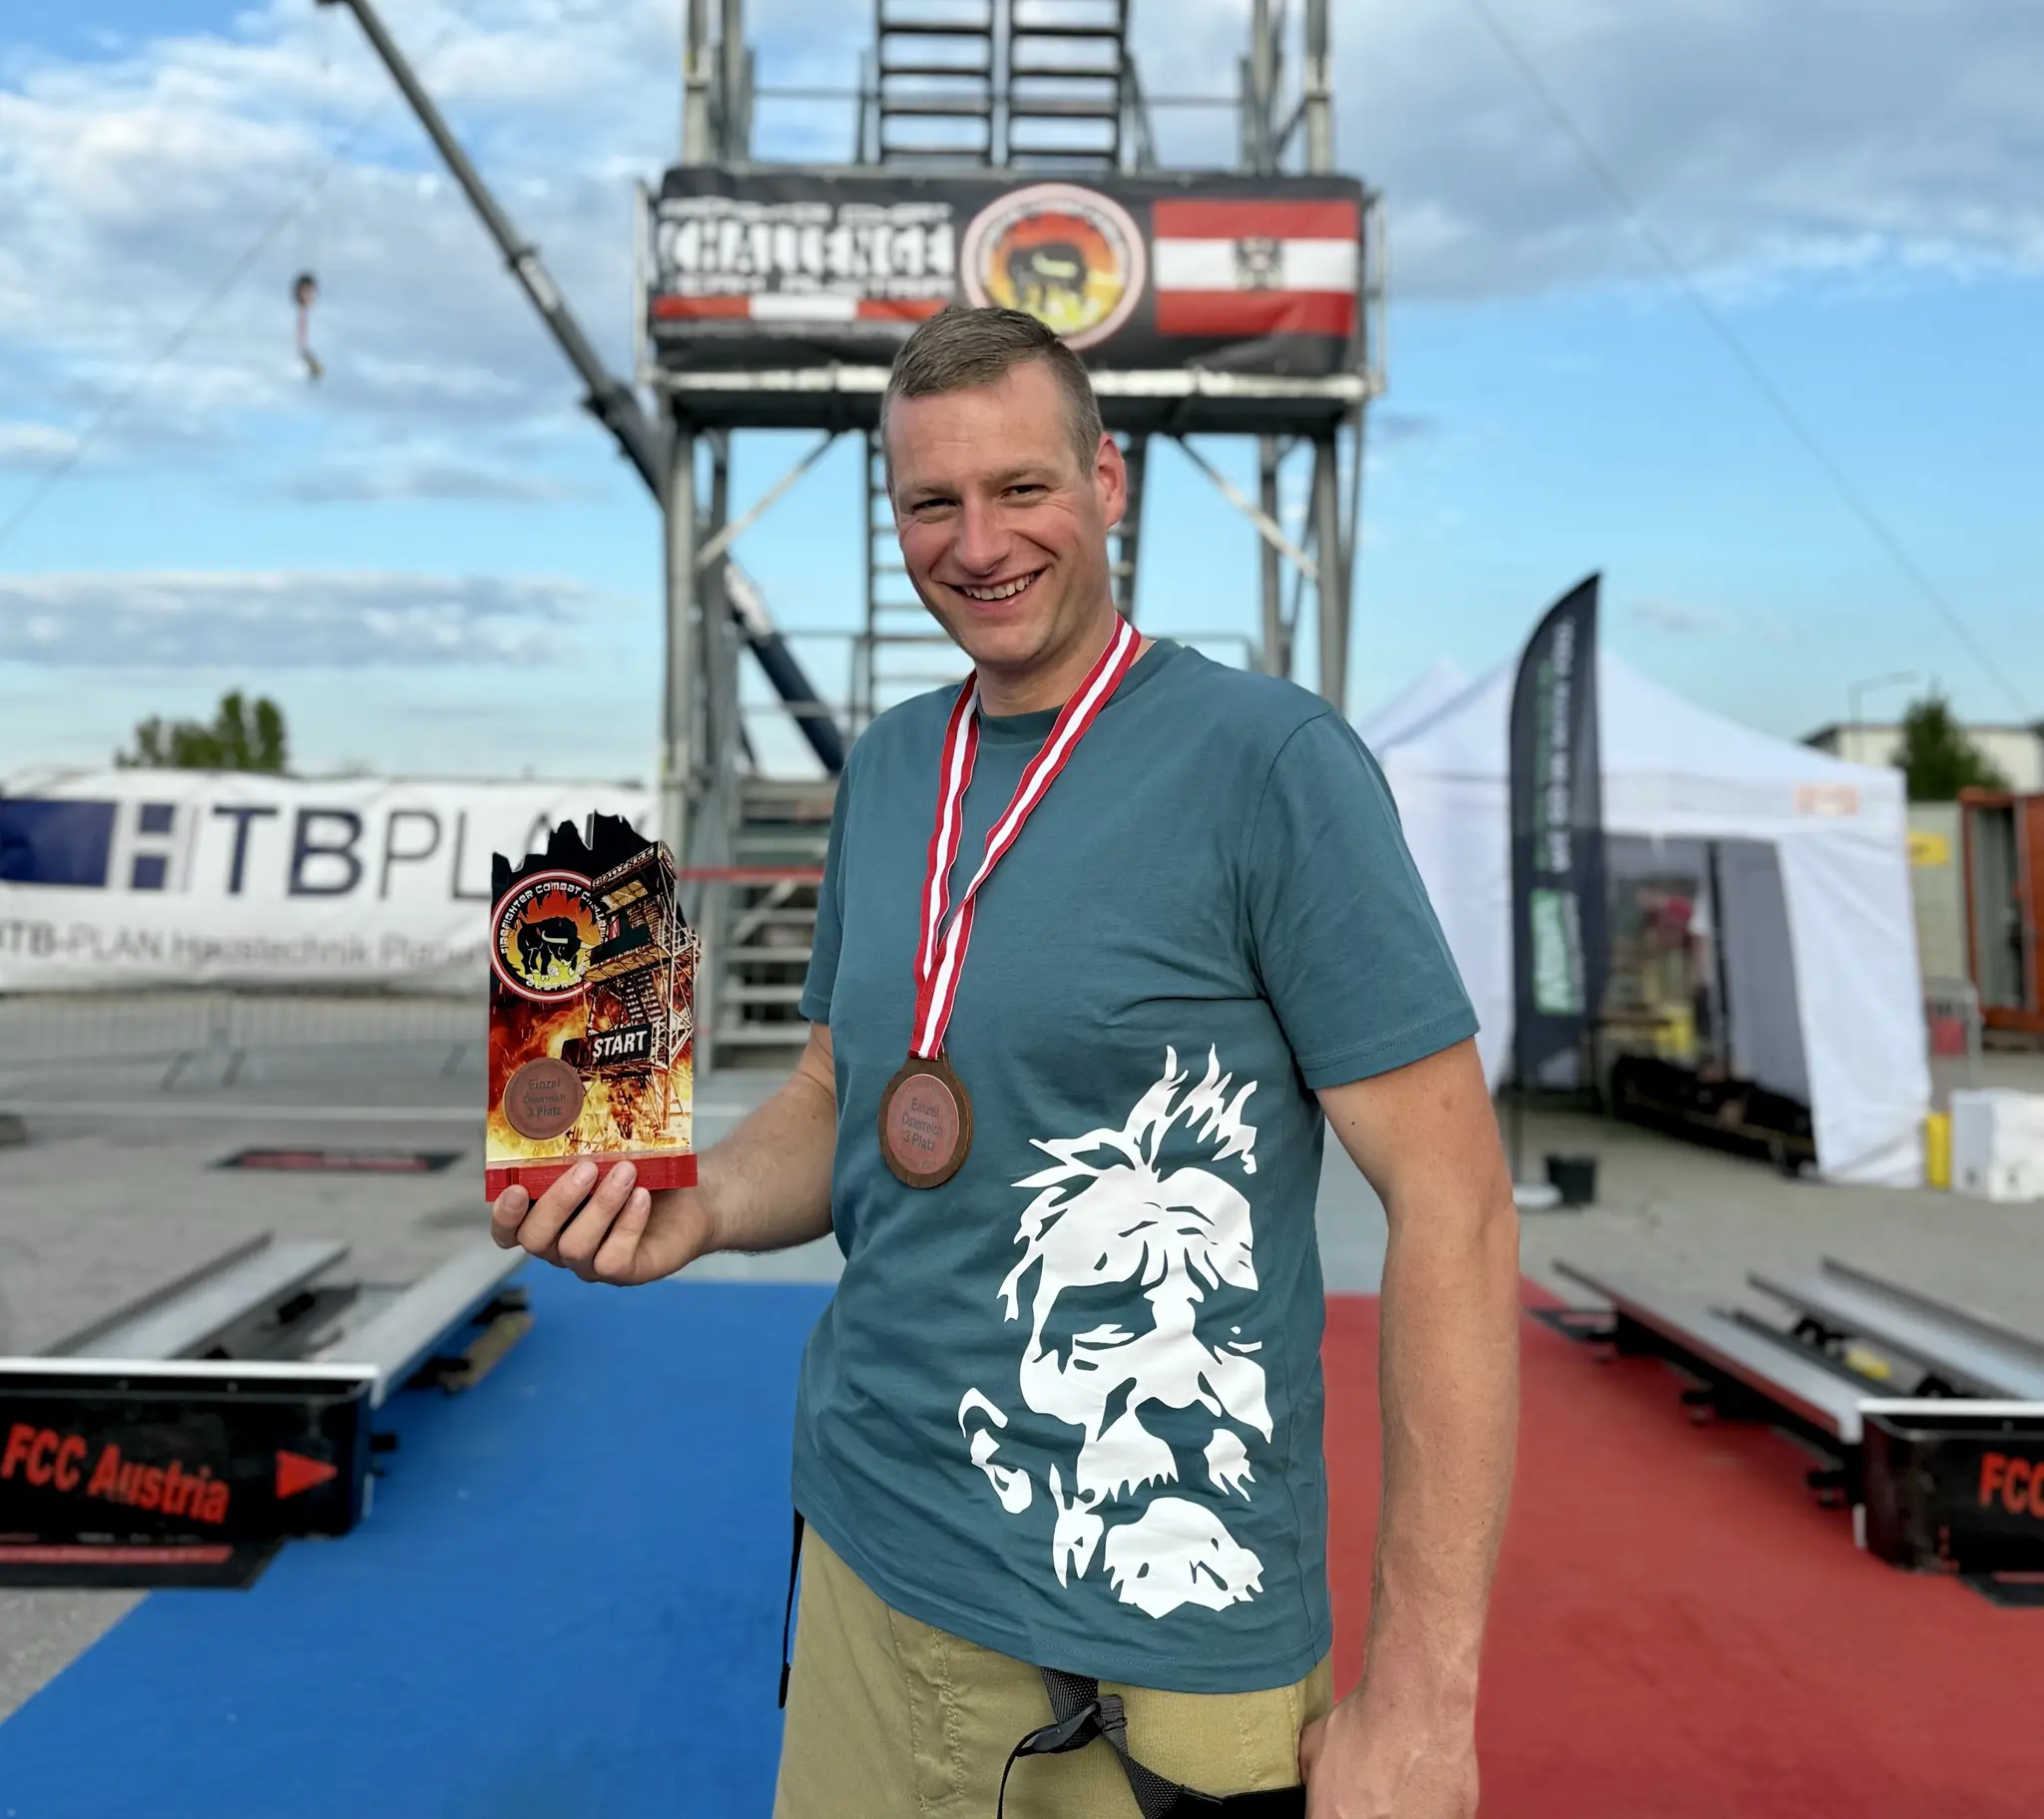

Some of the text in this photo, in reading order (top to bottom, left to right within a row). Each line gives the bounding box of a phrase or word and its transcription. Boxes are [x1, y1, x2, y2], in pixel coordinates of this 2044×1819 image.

[592, 1030, 648, 1059] START
[910, 1098, 940, 1118] Einzel
[1, 1422, 232, 1525] FCC Austria
